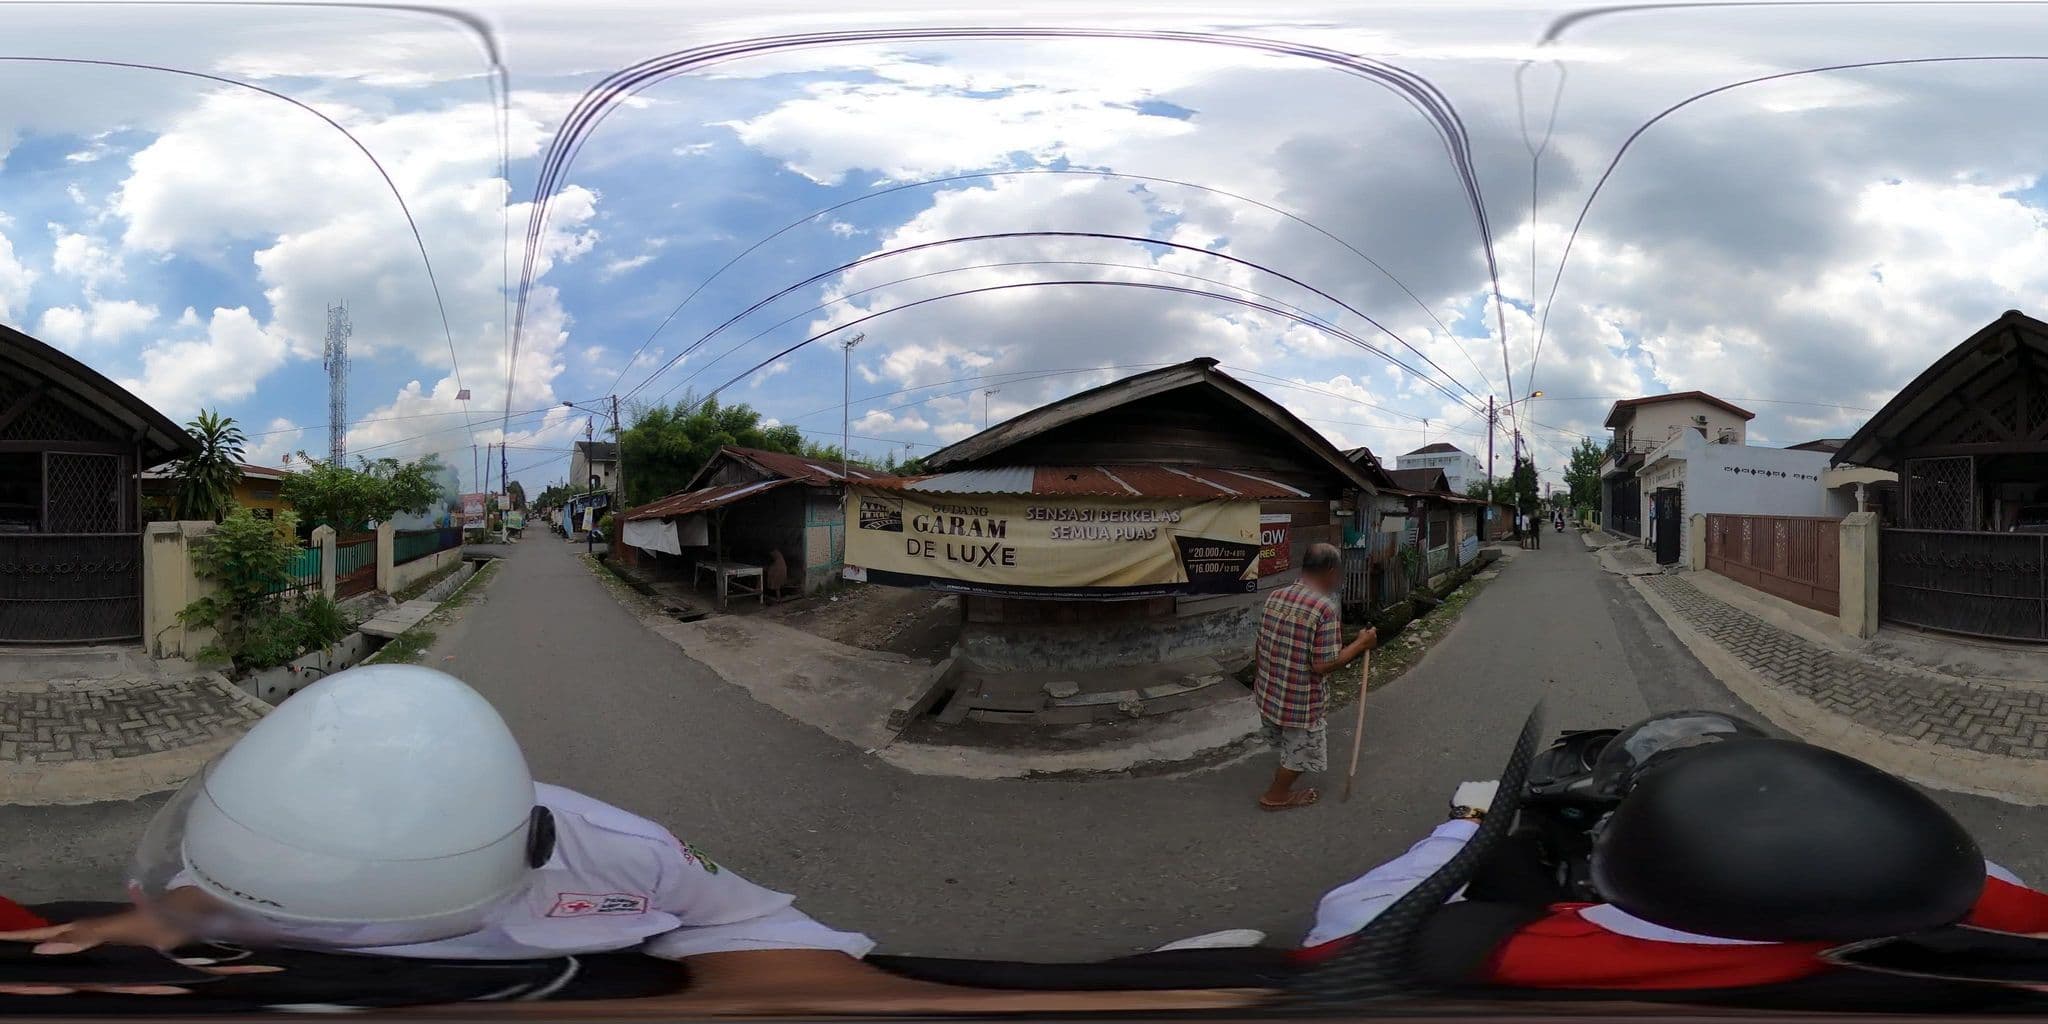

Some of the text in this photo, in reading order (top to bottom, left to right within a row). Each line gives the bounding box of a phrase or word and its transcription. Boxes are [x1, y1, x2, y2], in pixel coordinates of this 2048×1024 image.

[932, 504, 989, 516] GUDANG
[1025, 506, 1181, 524] SENSASI BERKELAS
[913, 514, 1007, 539] GARAM
[1050, 525, 1156, 541] SEMUA PUAS
[907, 538, 1016, 567] DE LUXE
